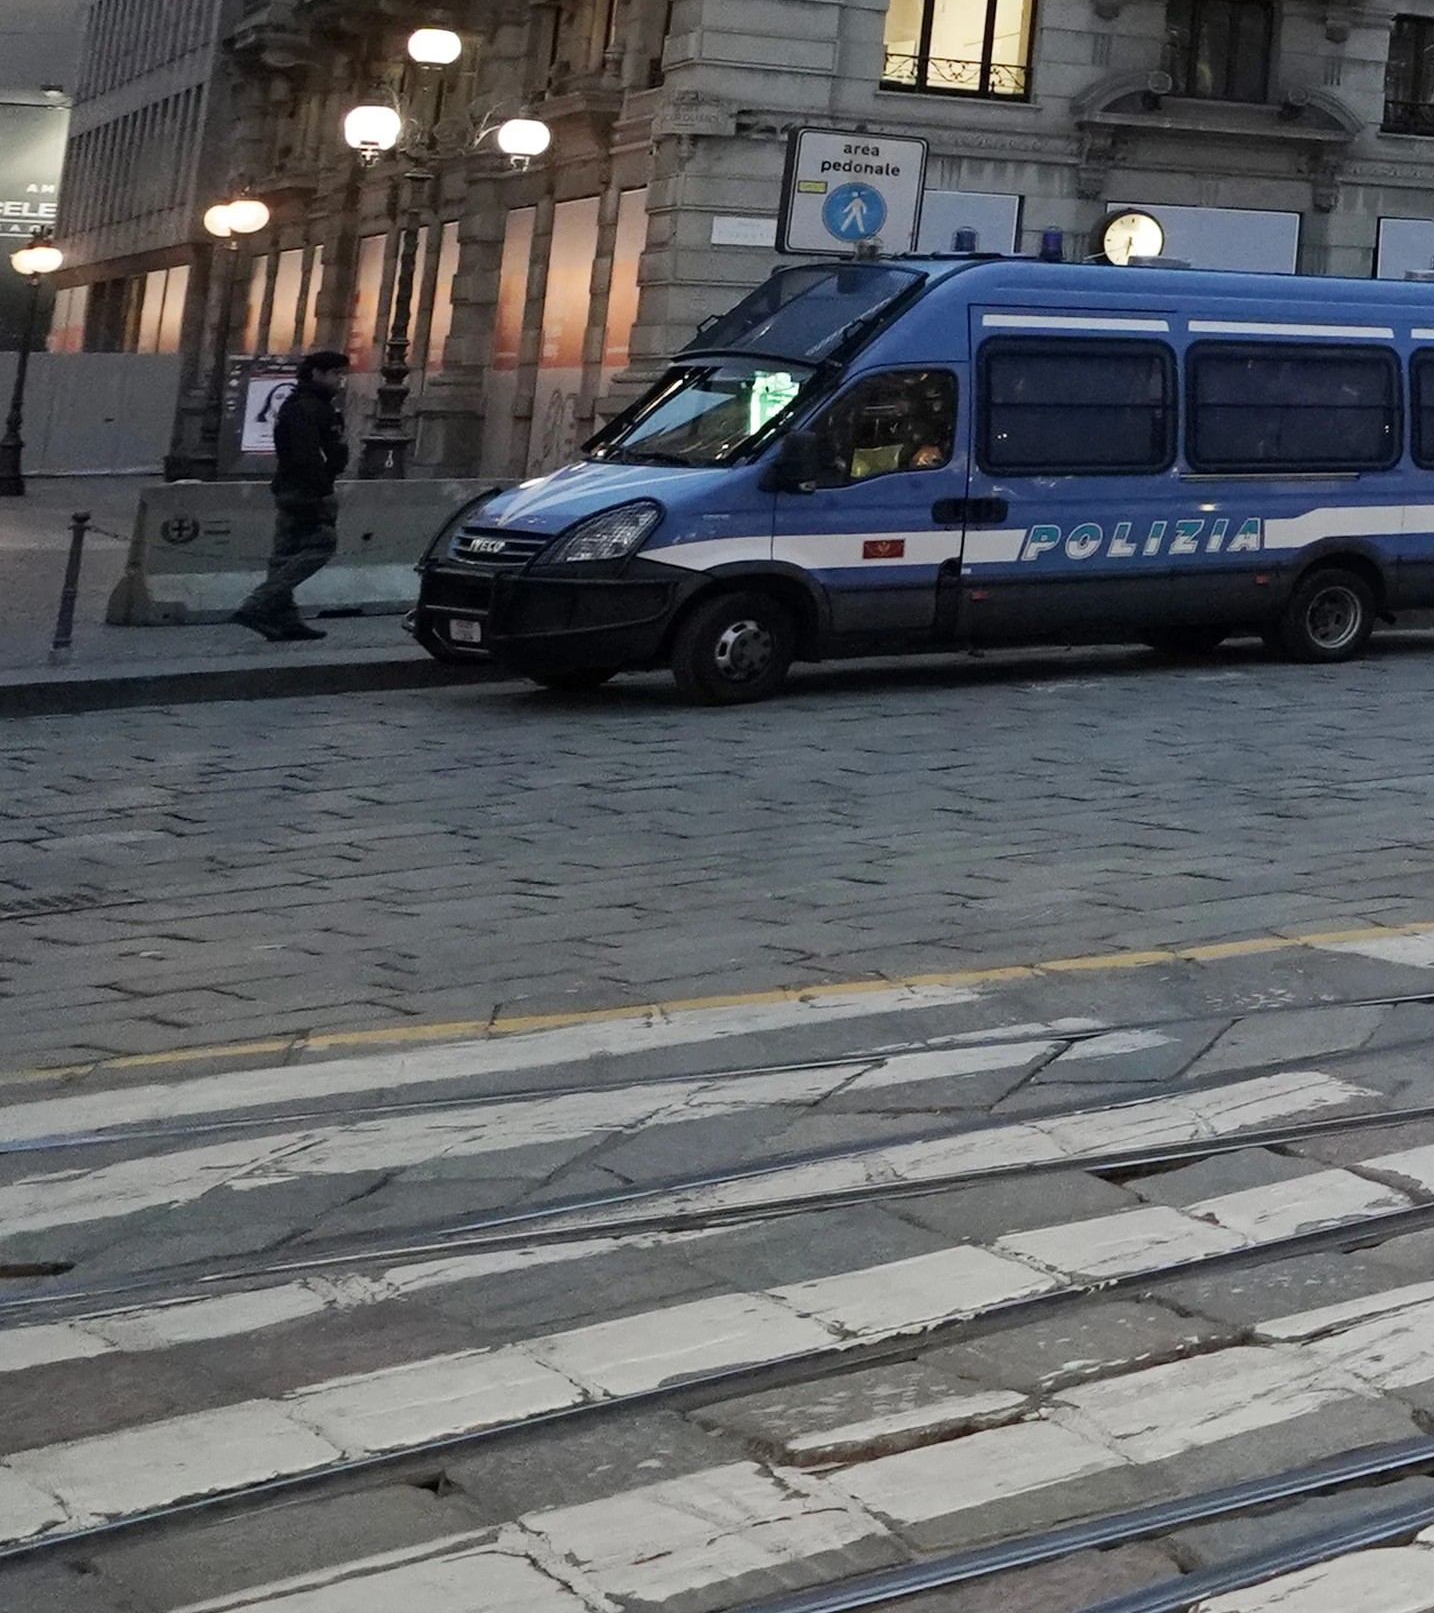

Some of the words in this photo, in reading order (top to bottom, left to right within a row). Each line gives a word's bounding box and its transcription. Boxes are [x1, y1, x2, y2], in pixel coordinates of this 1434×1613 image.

[843, 144, 880, 157] area
[820, 159, 901, 177] pedonale
[470, 538, 506, 554] IVECO
[1021, 517, 1262, 562] POLIZIA
